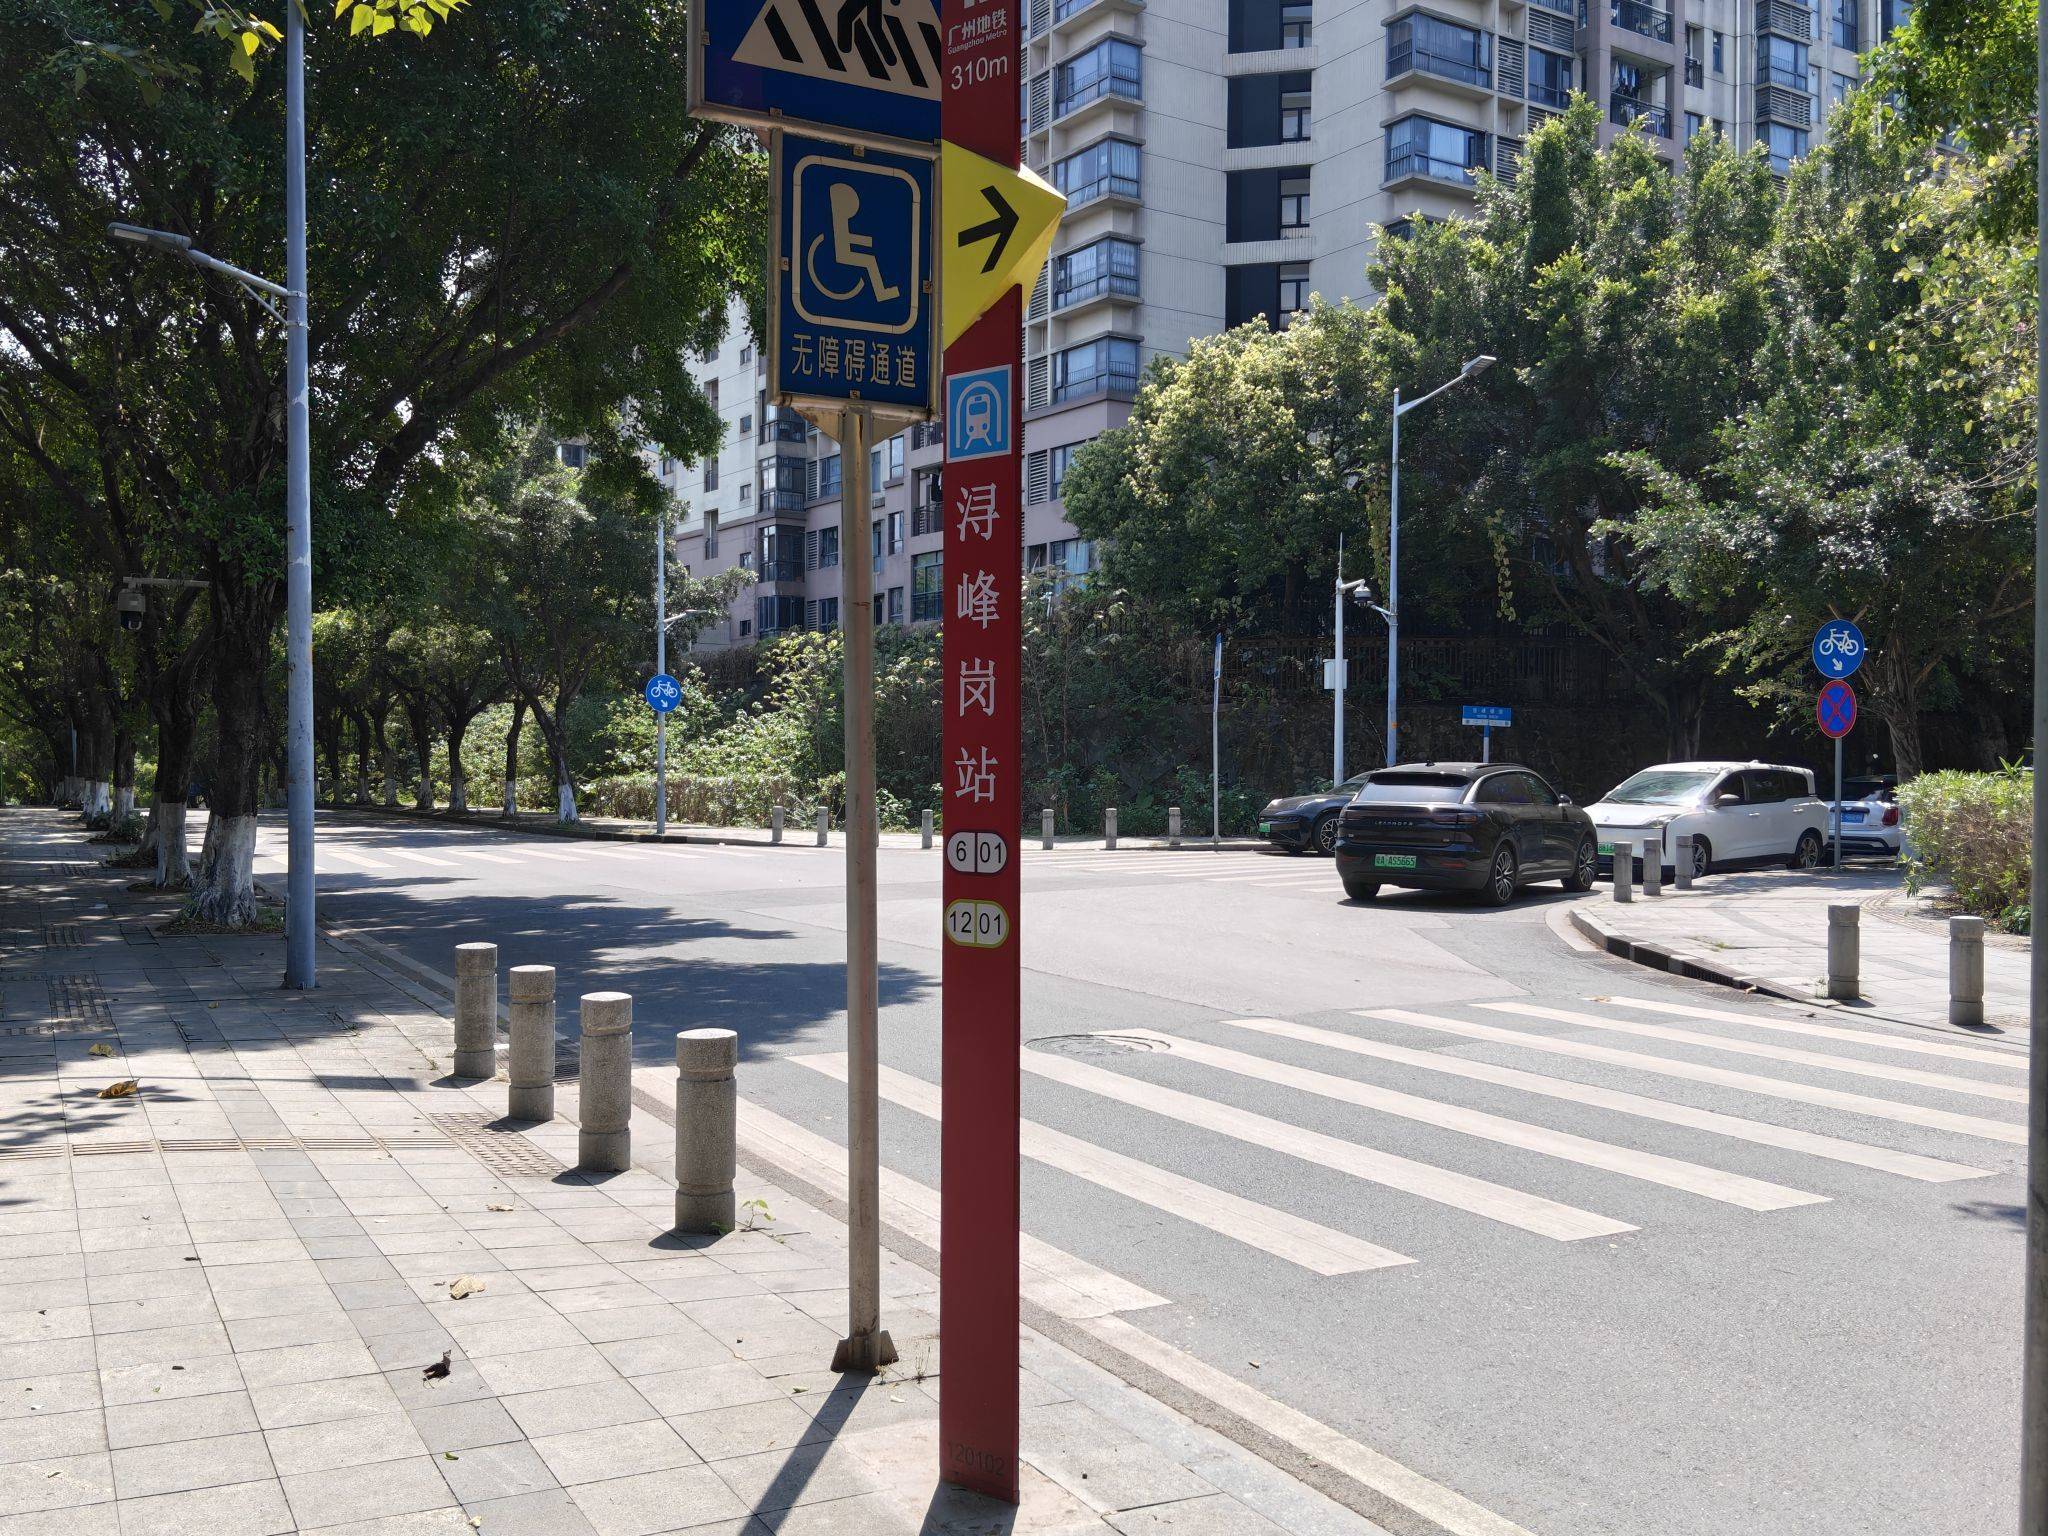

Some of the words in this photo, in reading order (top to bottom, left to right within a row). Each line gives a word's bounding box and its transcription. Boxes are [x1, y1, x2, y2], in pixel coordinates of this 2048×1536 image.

[947, 37, 985, 55] Guangzhou
[985, 29, 1007, 42] Metro
[948, 8, 1007, 46] 广州地铁
[951, 55, 1008, 90] 310m
[791, 333, 916, 388] 无障碍通道
[955, 482, 1000, 804] 浔峰岗站
